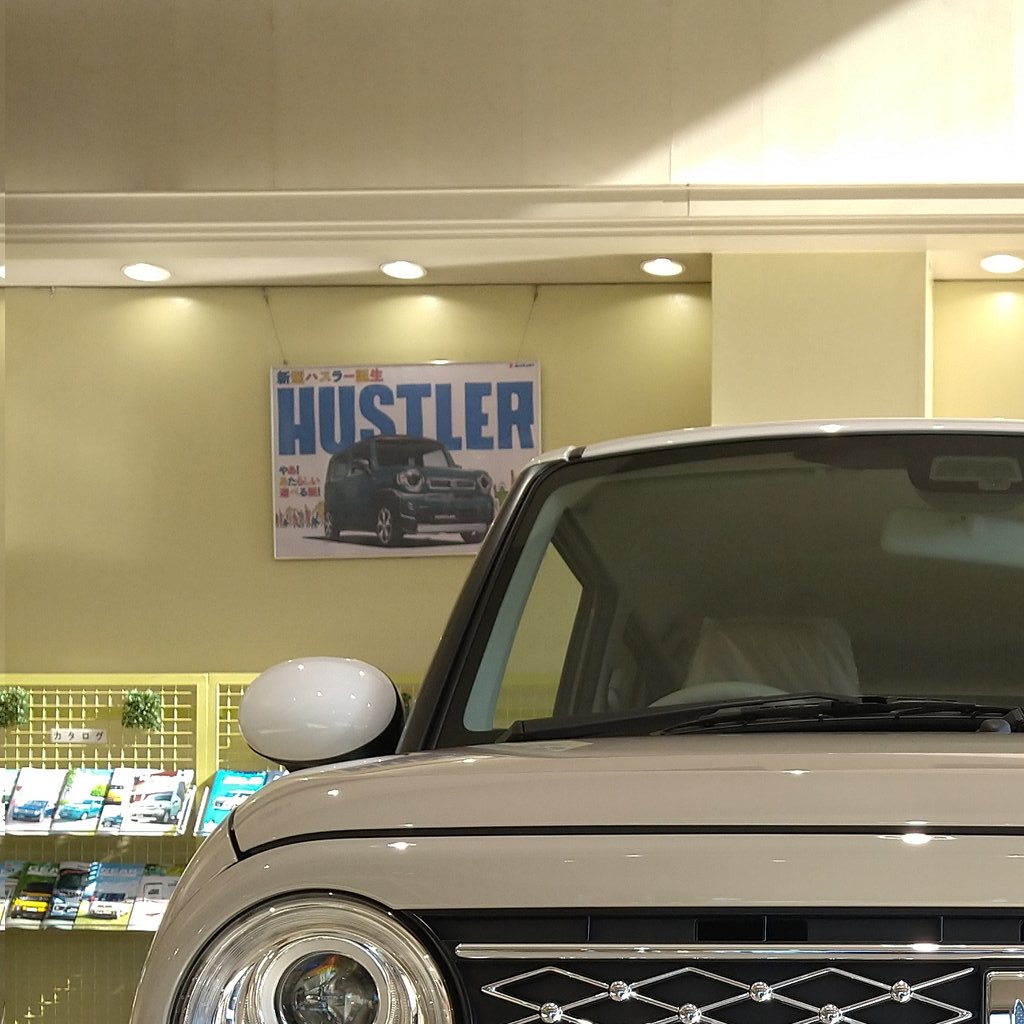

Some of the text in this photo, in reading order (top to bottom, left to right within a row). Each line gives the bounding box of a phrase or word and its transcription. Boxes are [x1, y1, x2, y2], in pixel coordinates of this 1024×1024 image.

[277, 381, 535, 455] HUSTLER
[54, 731, 104, 741] カタログ
